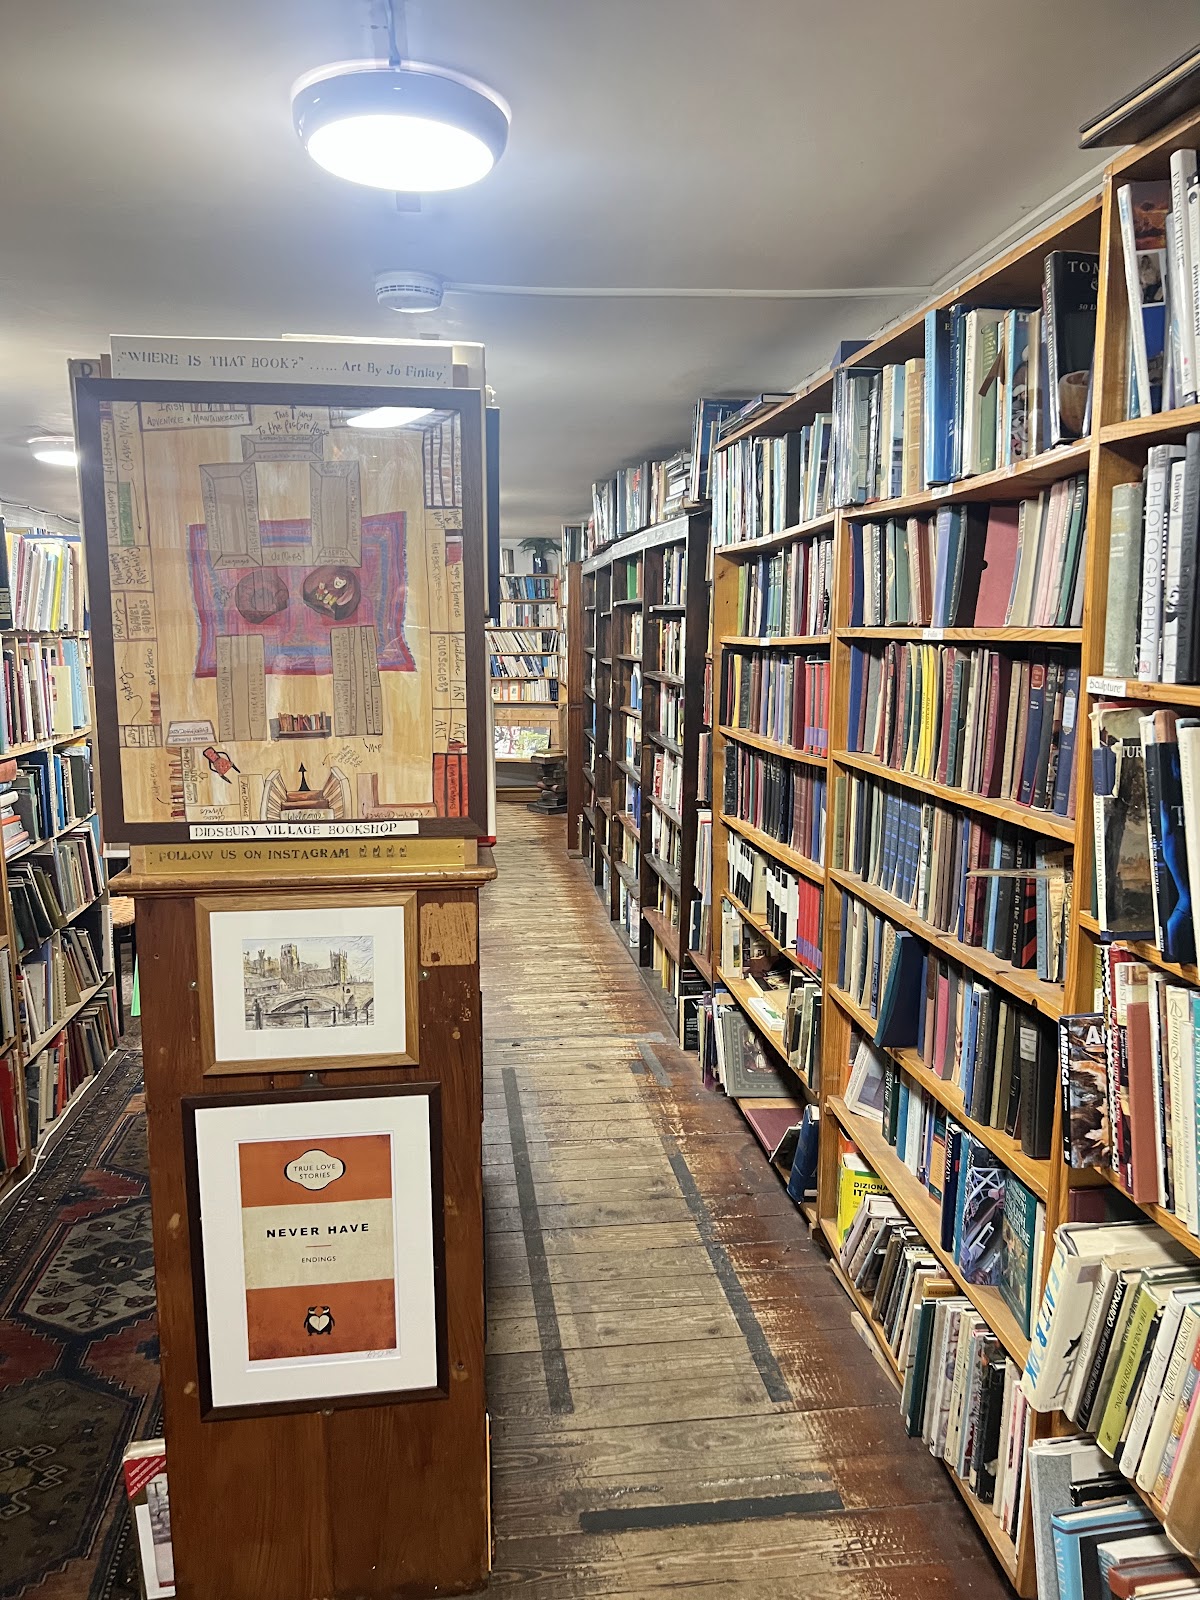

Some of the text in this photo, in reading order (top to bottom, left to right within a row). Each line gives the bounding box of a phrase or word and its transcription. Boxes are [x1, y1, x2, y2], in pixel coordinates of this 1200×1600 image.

[188, 354, 202, 366] IS
[210, 355, 246, 368] THAT
[342, 360, 362, 374] Art
[367, 362, 382, 377] By
[386, 364, 401, 377] Jo
[406, 364, 444, 382] Finlay
[1172, 474, 1182, 513] Banksy
[1142, 481, 1162, 644] PHOTOGRAPHY
[454, 685, 465, 702] ART
[1089, 678, 1122, 694] Sculpture
[434, 720, 447, 740] ART
[453, 722, 467, 742] ART
[194, 822, 398, 838] DIDSBURY VILLAGE BOOKSHOP
[1096, 816, 1104, 831] ON
[158, 847, 350, 862] FOLLOW US ON INSTAGRAM
[1097, 857, 1105, 900] THAMES
[1169, 998, 1182, 1046] Lasting
[1060, 1024, 1069, 1086] AMERICA
[293, 1164, 313, 1172] TRUE
[266, 1223, 370, 1238] NEVER HAVE
[301, 1256, 336, 1264] ENDINGS
[1104, 1281, 1125, 1328] LEONARDO
[1020, 1322, 1051, 1390] BOOK
